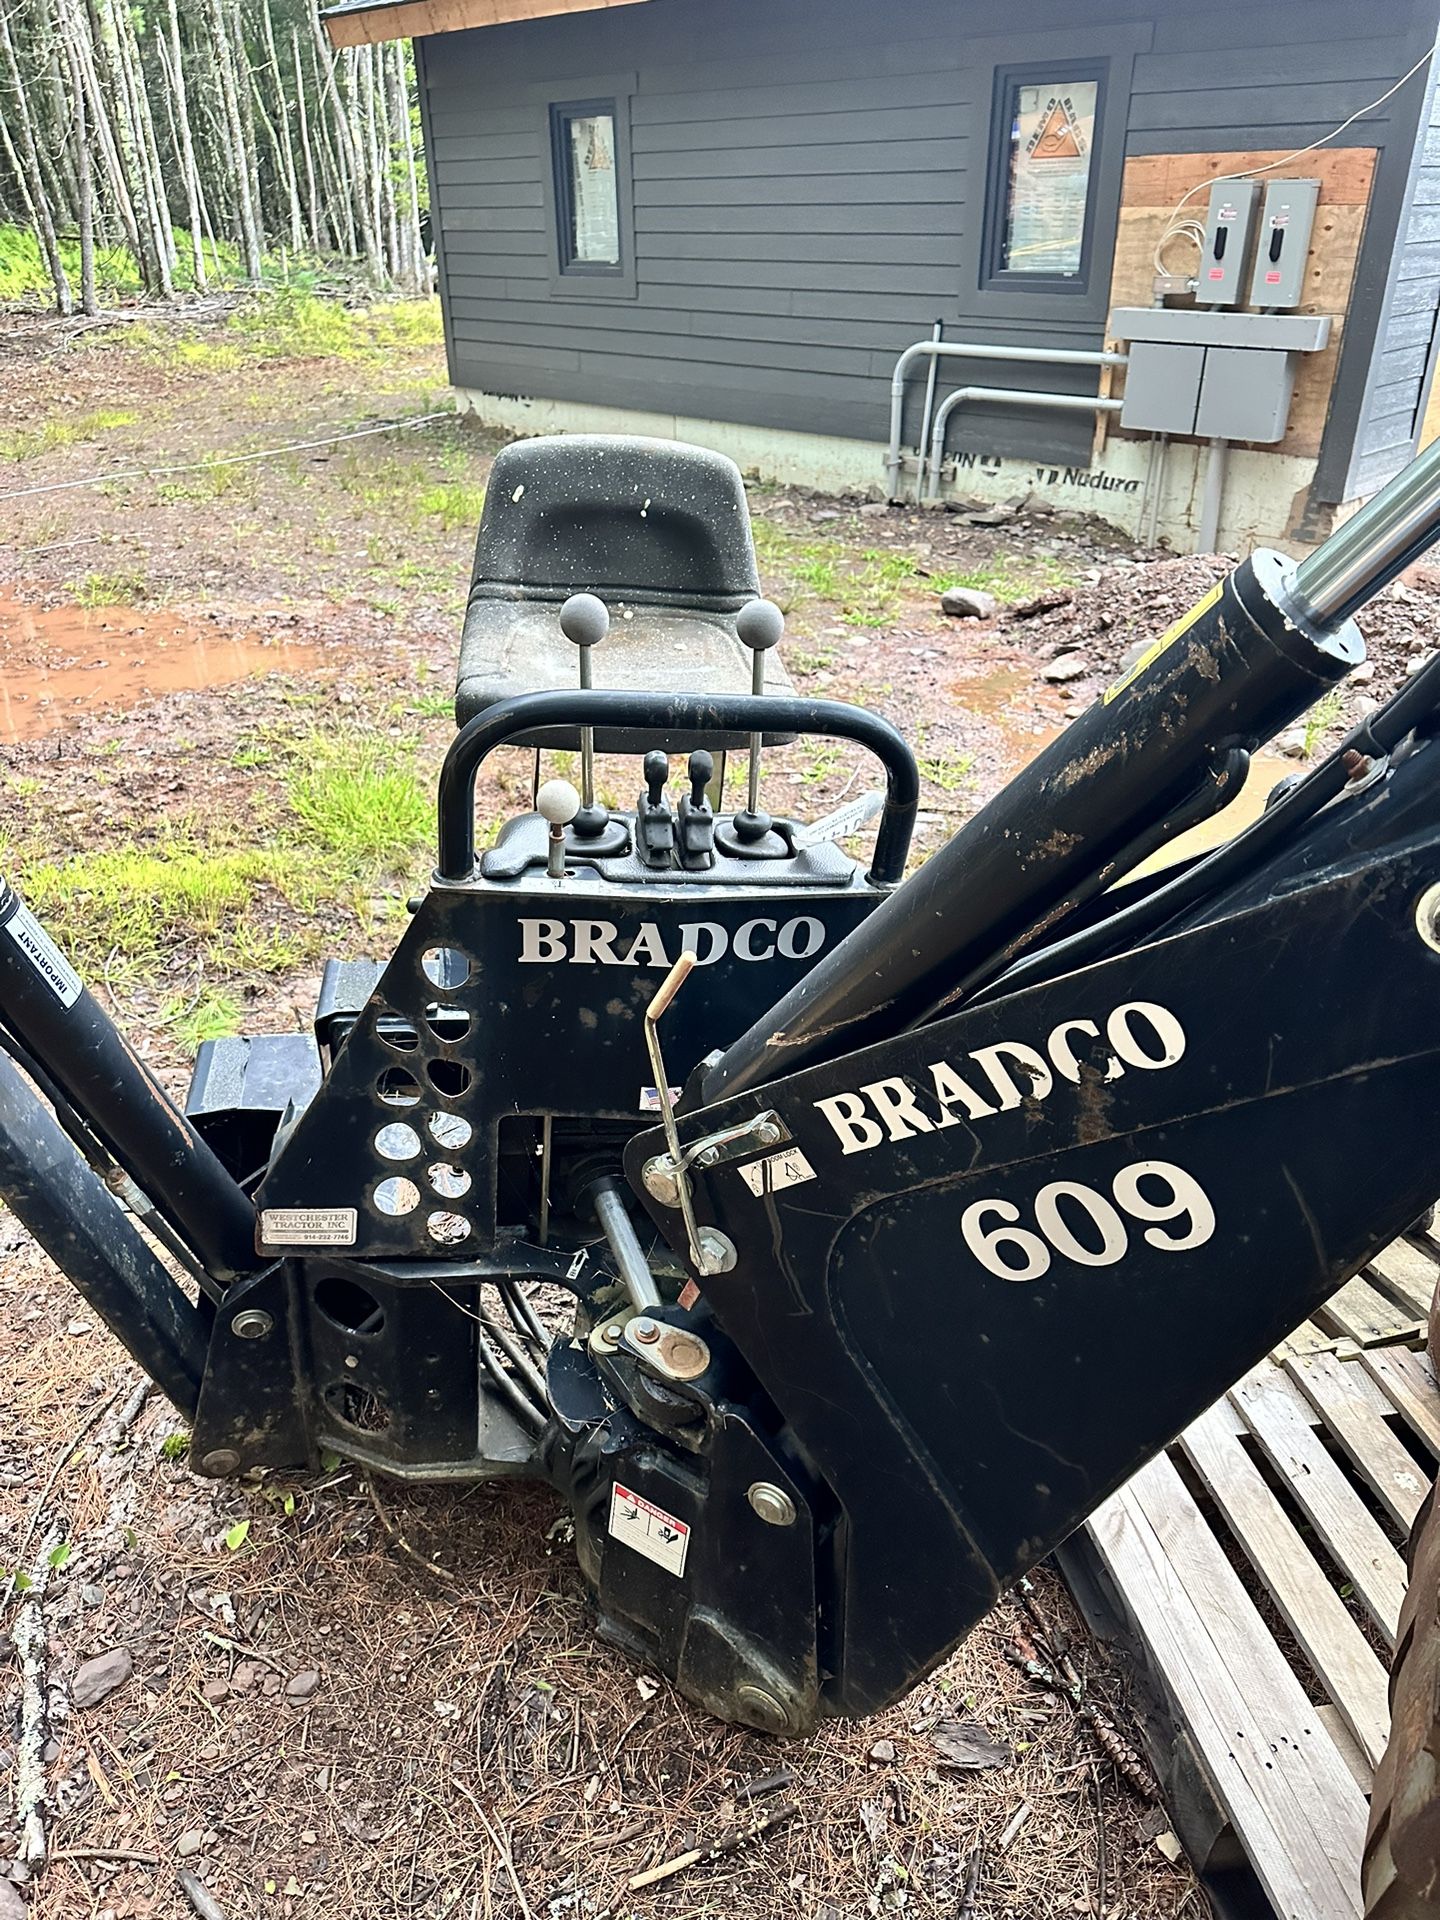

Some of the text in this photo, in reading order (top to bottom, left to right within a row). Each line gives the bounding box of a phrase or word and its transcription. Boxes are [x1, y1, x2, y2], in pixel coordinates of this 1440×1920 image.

[1062, 467, 1140, 494] Nudura
[517, 915, 826, 968] BRADCO
[17, 931, 68, 994] IMPORTANT
[813, 1001, 1186, 1155] BRADCO
[782, 1149, 799, 1158] LOCK
[269, 1214, 349, 1222] WESTCHESTER
[960, 1160, 1216, 1281] 609
[636, 1500, 677, 1527] DANGER
